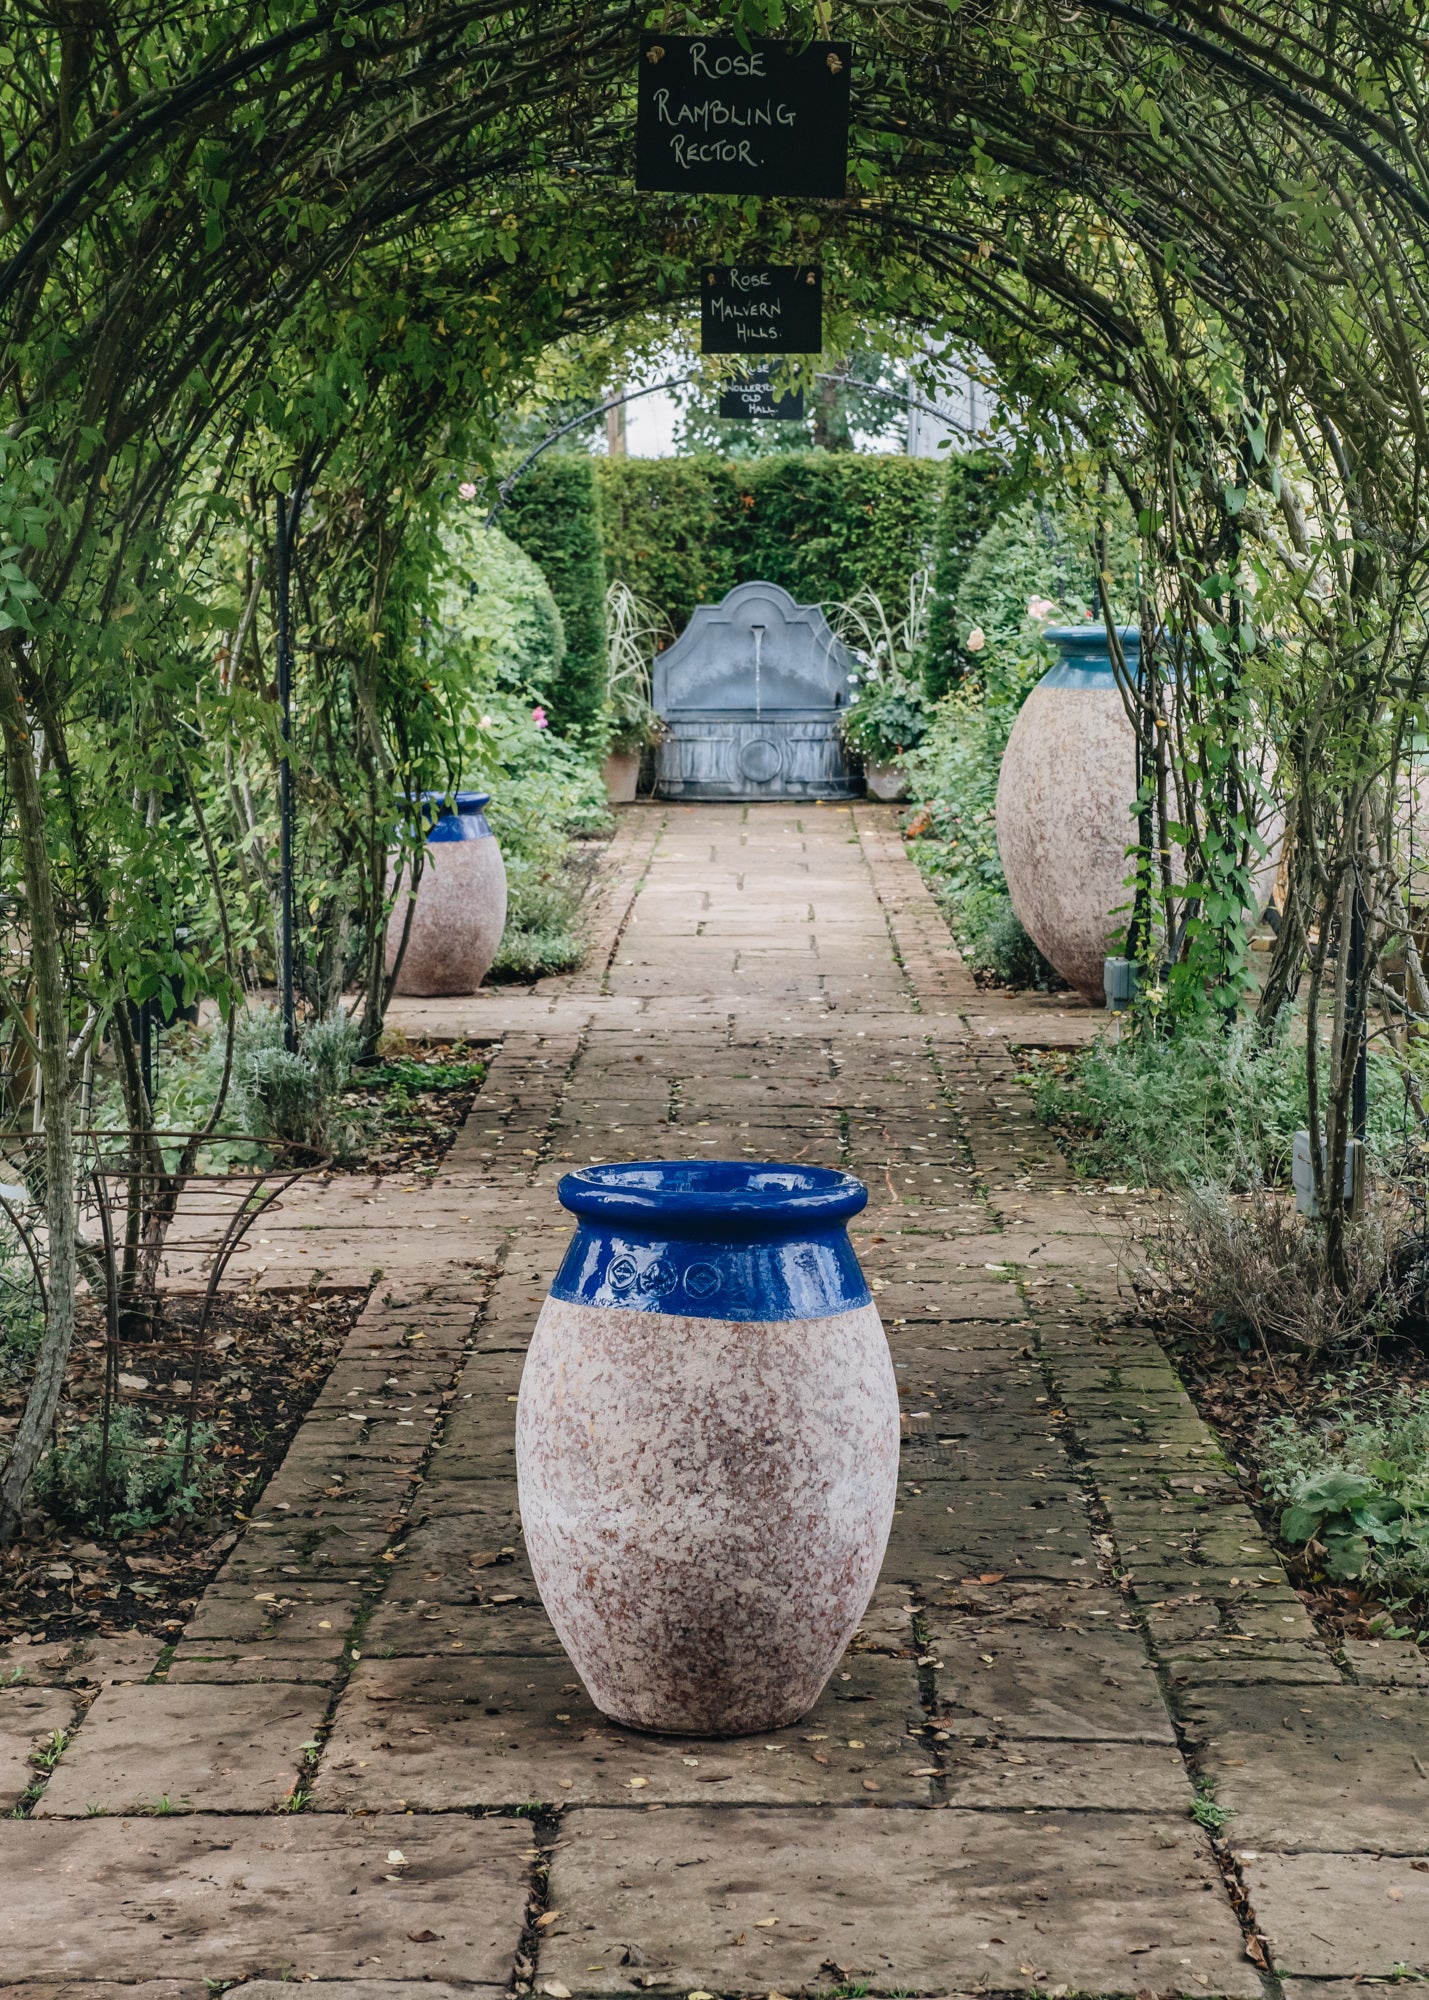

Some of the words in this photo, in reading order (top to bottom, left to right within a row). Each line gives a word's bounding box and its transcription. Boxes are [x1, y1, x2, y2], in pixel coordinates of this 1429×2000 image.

[690, 42, 766, 79] ROSE
[653, 88, 797, 132] RAMBLING
[670, 134, 765, 169] RECTOR.
[730, 268, 771, 292] ROSE
[711, 296, 781, 322] MALVERN
[737, 323, 782, 343] HILLS.
[746, 364, 770, 376] OSE
[741, 394, 761, 402] OLD
